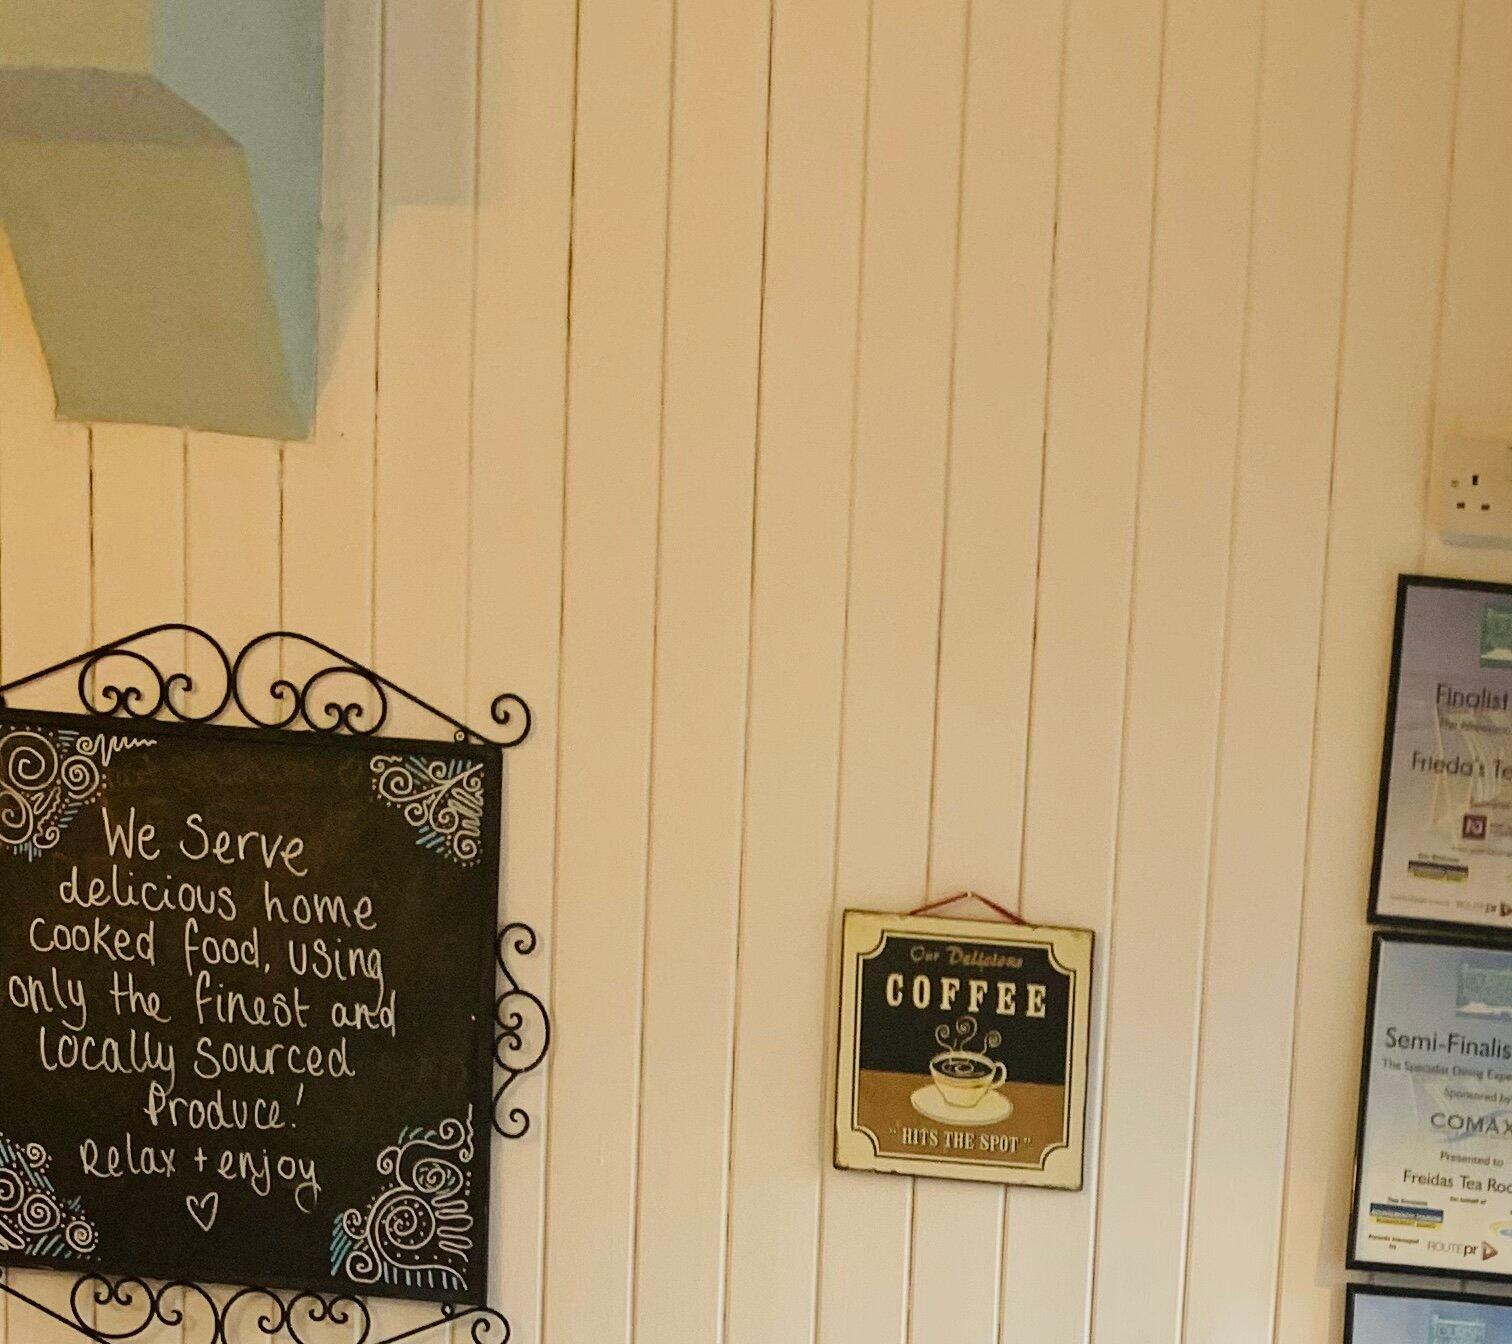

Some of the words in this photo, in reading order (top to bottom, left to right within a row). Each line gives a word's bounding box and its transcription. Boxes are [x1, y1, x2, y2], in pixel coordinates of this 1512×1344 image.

[1437, 683, 1508, 710] Finalist
[1412, 751, 1485, 778] Frieda's
[102, 807, 160, 860] We
[60, 865, 236, 921] delicious
[265, 881, 376, 930] home
[911, 945, 939, 962] Our
[8, 967, 87, 1031] only
[109, 971, 171, 1022] the
[196, 970, 310, 1027] finest
[331, 990, 397, 1037] and
[886, 973, 1046, 1018] COFFEE
[944, 1131, 974, 1149] THE
[79, 1132, 176, 1178] Relax
[219, 1149, 321, 1213] enjoy
[1440, 1151, 1490, 1166] Presented
[1493, 1158, 1504, 1167] to
[1403, 1169, 1453, 1188] Freidas
[1460, 1175, 1483, 1191] Tea
